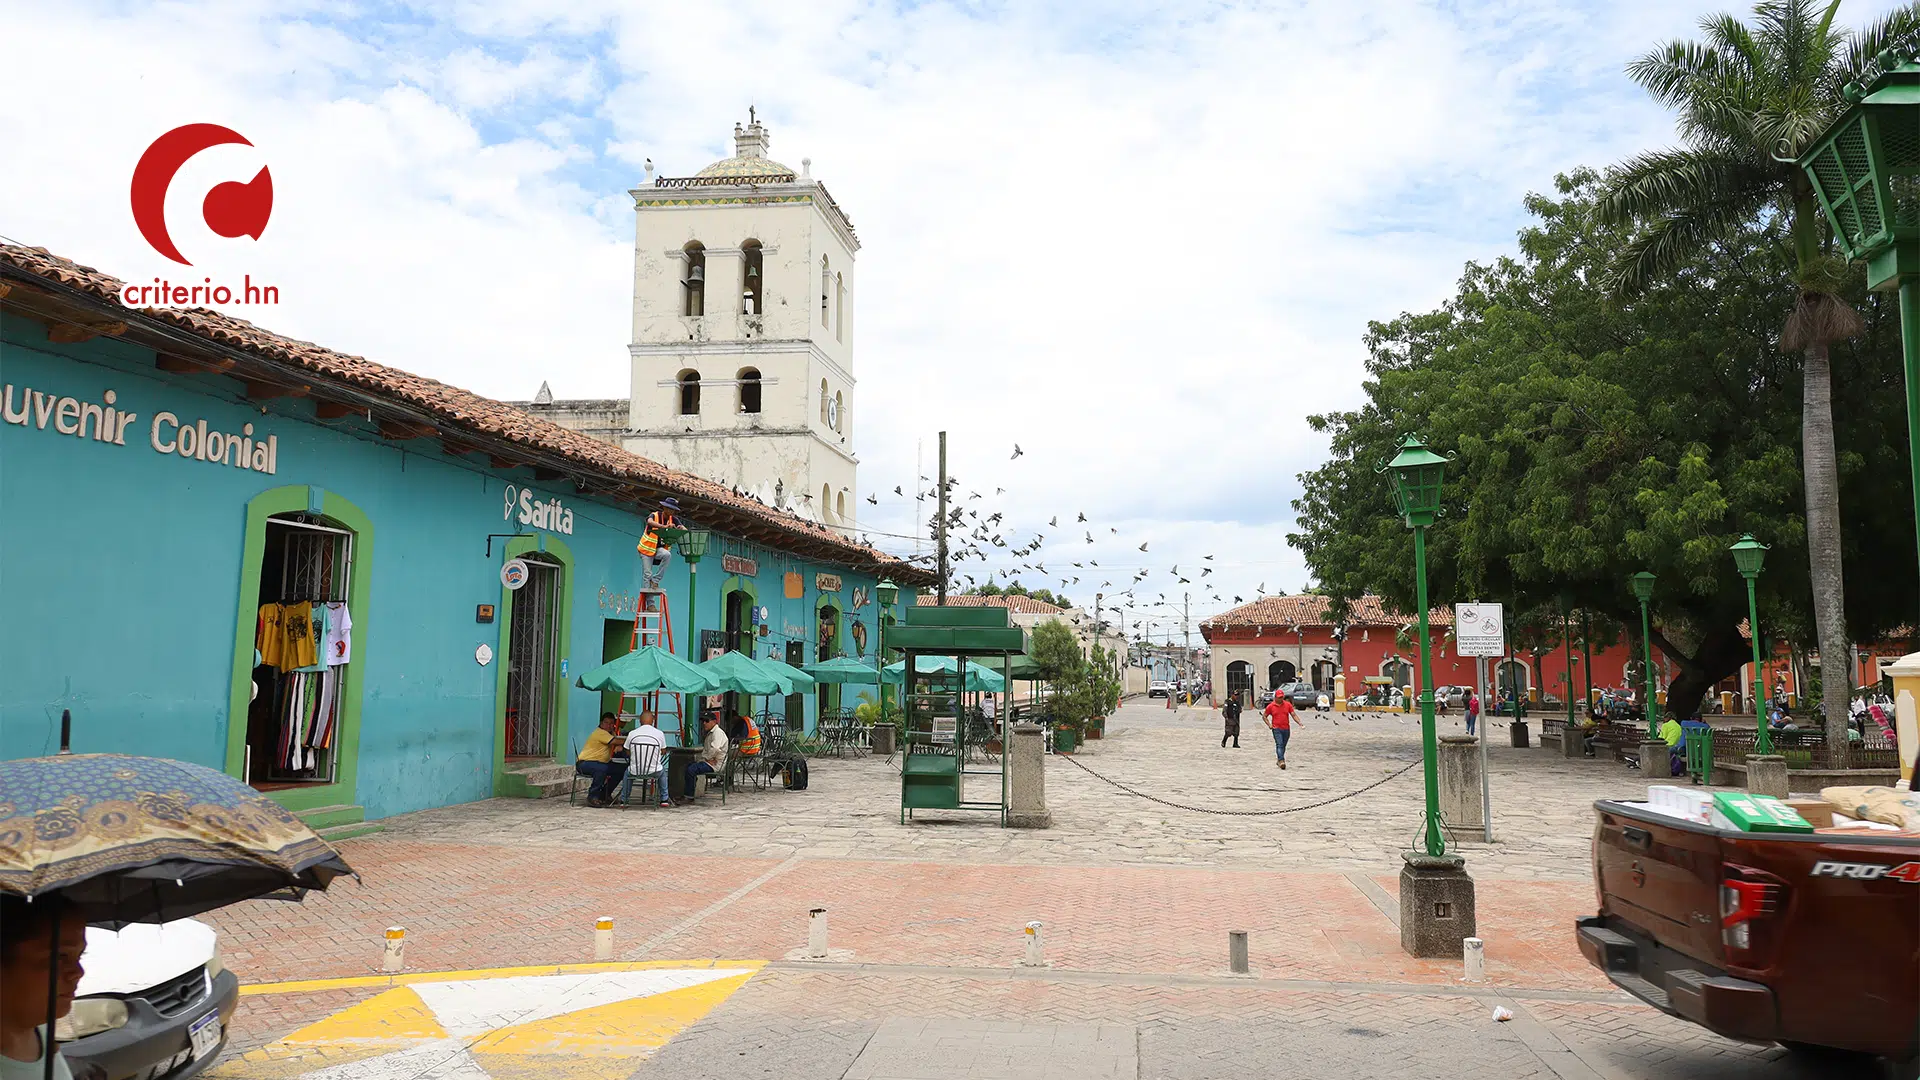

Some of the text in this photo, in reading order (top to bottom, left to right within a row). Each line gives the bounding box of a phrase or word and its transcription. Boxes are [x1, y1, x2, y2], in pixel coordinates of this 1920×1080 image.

[0, 384, 278, 475] uvenir Colonial
[518, 488, 574, 535] Sarita
